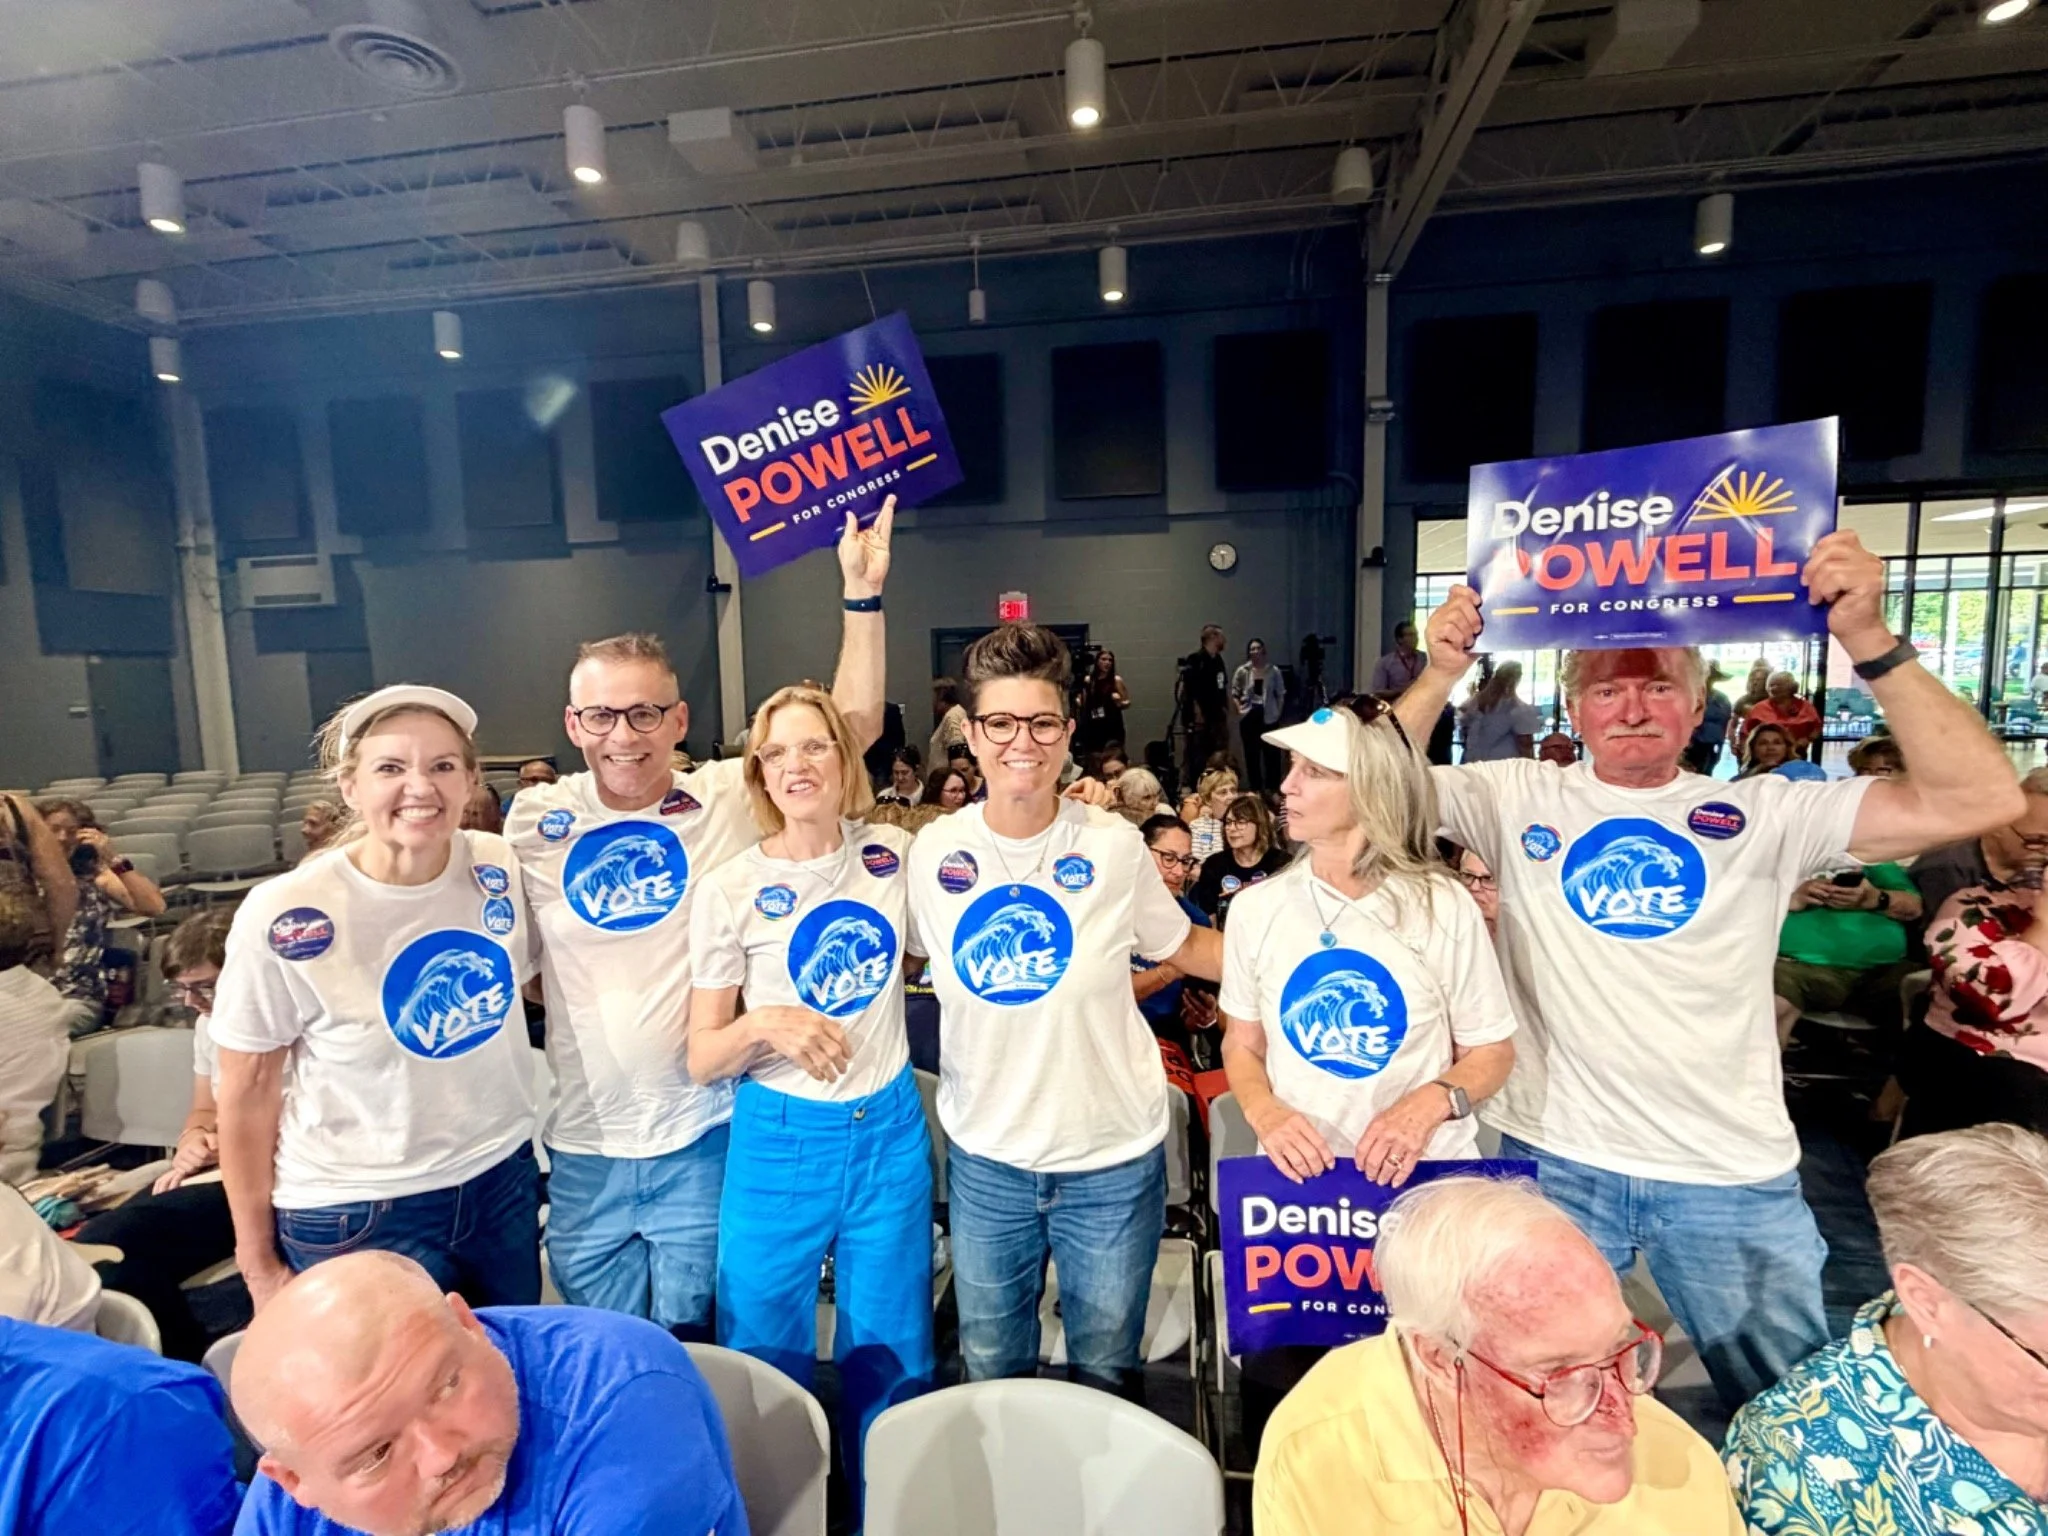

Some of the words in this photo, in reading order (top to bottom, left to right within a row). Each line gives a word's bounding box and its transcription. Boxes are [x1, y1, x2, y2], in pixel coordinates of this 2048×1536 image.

[700, 398, 840, 476] Denise
[723, 406, 932, 523] POWELL
[792, 504, 822, 525] FOR
[826, 469, 901, 509] CONGRESS
[1492, 491, 1674, 539] Denise
[1550, 603, 1589, 614] FOR
[1600, 596, 1719, 612] CONGRESS
[580, 870, 676, 918] VOTE
[1578, 885, 1687, 917] VOTE
[812, 951, 889, 1006] VOTE
[967, 947, 1057, 988] VOTE
[411, 982, 506, 1050] VOTE
[1294, 1024, 1391, 1054] VOTE
[1245, 1243, 1384, 1292] POW
[1302, 1301, 1337, 1312] FOR
